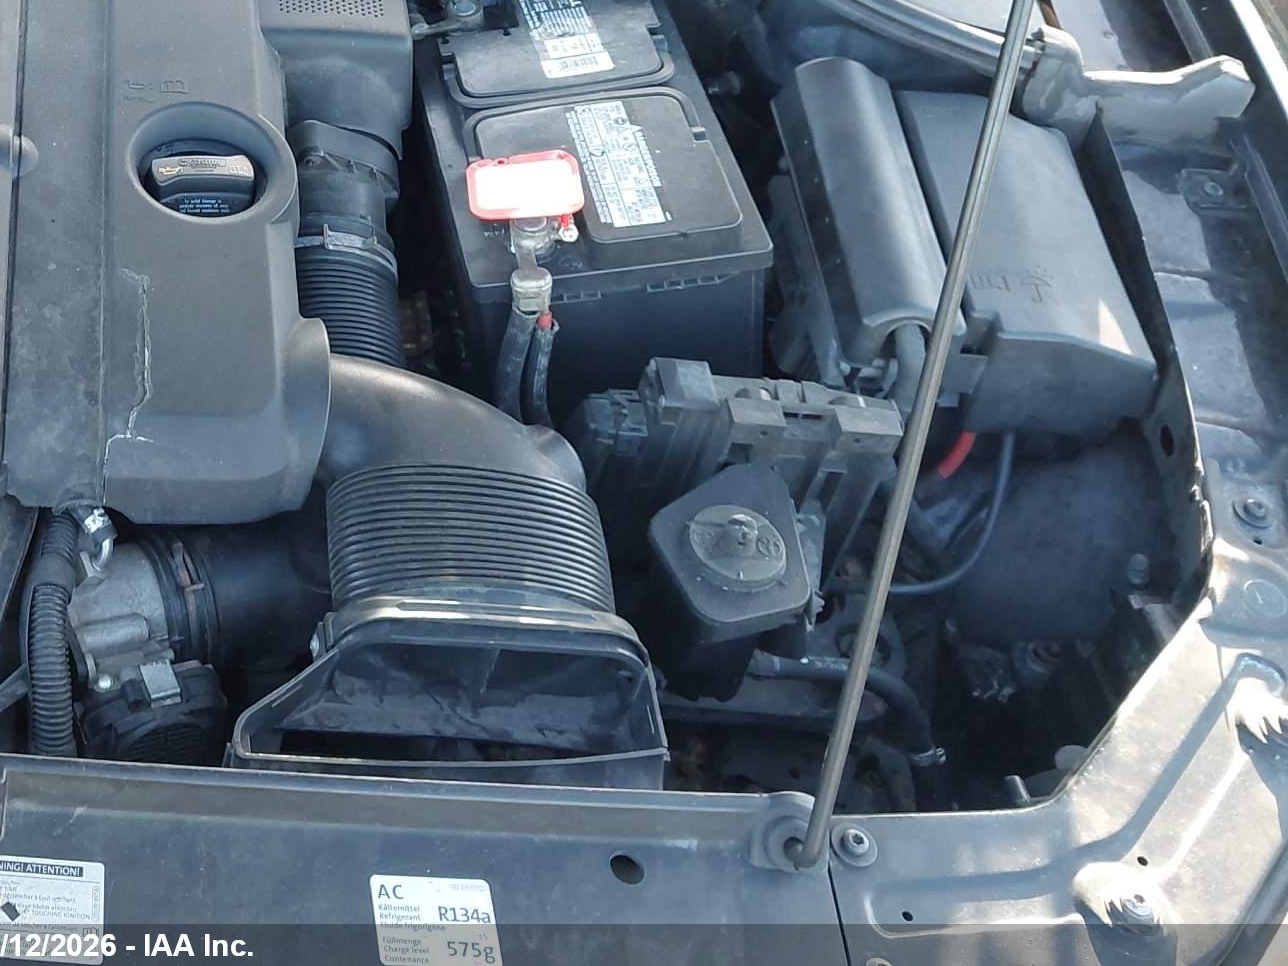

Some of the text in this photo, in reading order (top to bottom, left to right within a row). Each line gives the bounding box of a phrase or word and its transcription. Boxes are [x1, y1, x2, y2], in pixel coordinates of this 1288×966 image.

[26, 864, 80, 876] ATTENTION!
[379, 912, 421, 922] Refrigerant
[438, 906, 492, 924] R134a
[382, 936, 422, 946] Füllmenge
[384, 945, 430, 954] Charge level
[447, 941, 496, 964] 575g
[385, 955, 430, 963] Contenance
